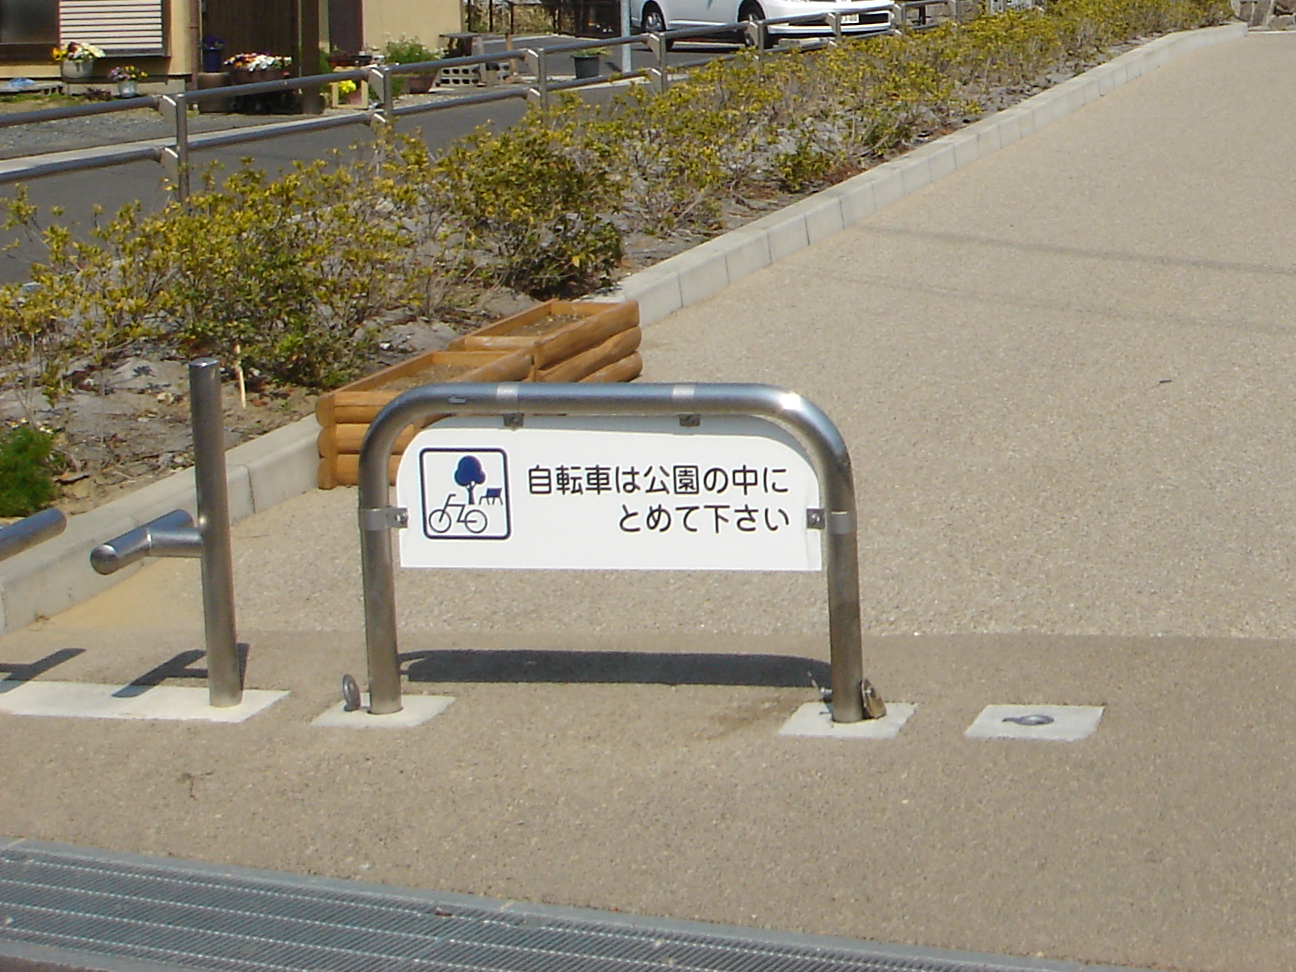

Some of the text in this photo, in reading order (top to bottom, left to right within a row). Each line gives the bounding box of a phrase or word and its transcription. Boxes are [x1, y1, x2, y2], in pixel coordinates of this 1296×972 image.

[528, 464, 789, 496] 自転車は公園の中に
[619, 503, 791, 534] とめて下さい
